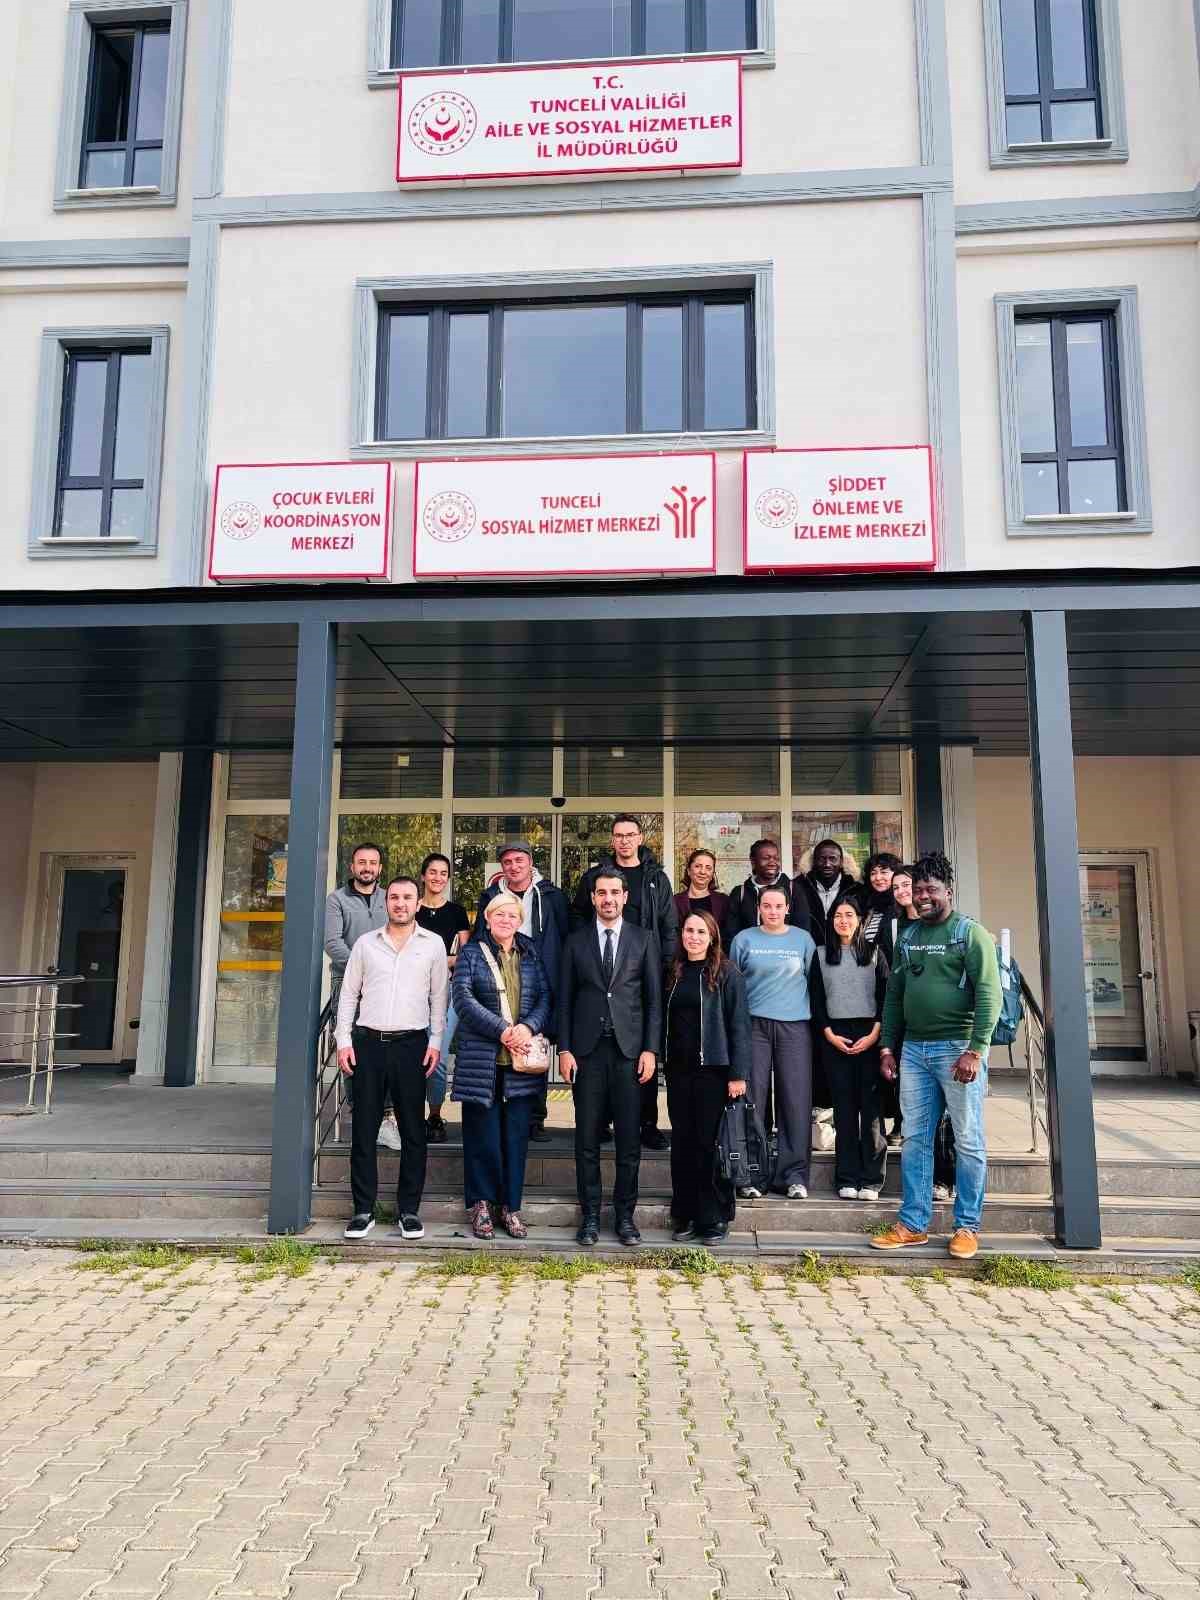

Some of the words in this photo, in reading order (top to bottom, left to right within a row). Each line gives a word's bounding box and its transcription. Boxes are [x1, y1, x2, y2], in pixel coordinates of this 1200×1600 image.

[592, 76, 624, 89] T.C.
[530, 97, 606, 113] TUNCELİ
[610, 93, 686, 111] VALİLİĞİ
[484, 121, 523, 138] AİLE
[527, 122, 550, 136] VE
[554, 120, 624, 135] SOSYAL
[628, 114, 733, 133] HİZMETLER
[537, 142, 553, 158] İL
[557, 139, 678, 157] MÜDÜRLÜĞÜ
[828, 475, 887, 495] ŞİDDET
[272, 492, 322, 509] ÇOCUK
[326, 488, 375, 505] EVLERİ
[541, 493, 601, 509] TUNCELİ
[812, 499, 880, 516] ÖNLEME
[883, 499, 903, 514] VE
[263, 511, 381, 528] KOORDİNASYON
[481, 519, 535, 535] SOSYAL
[539, 517, 594, 534] HİZMET
[597, 514, 661, 532] MERKEZİ
[794, 522, 852, 539] İZLEME
[855, 520, 926, 538] MERKEZİ
[291, 533, 355, 551] MERKEZİ
